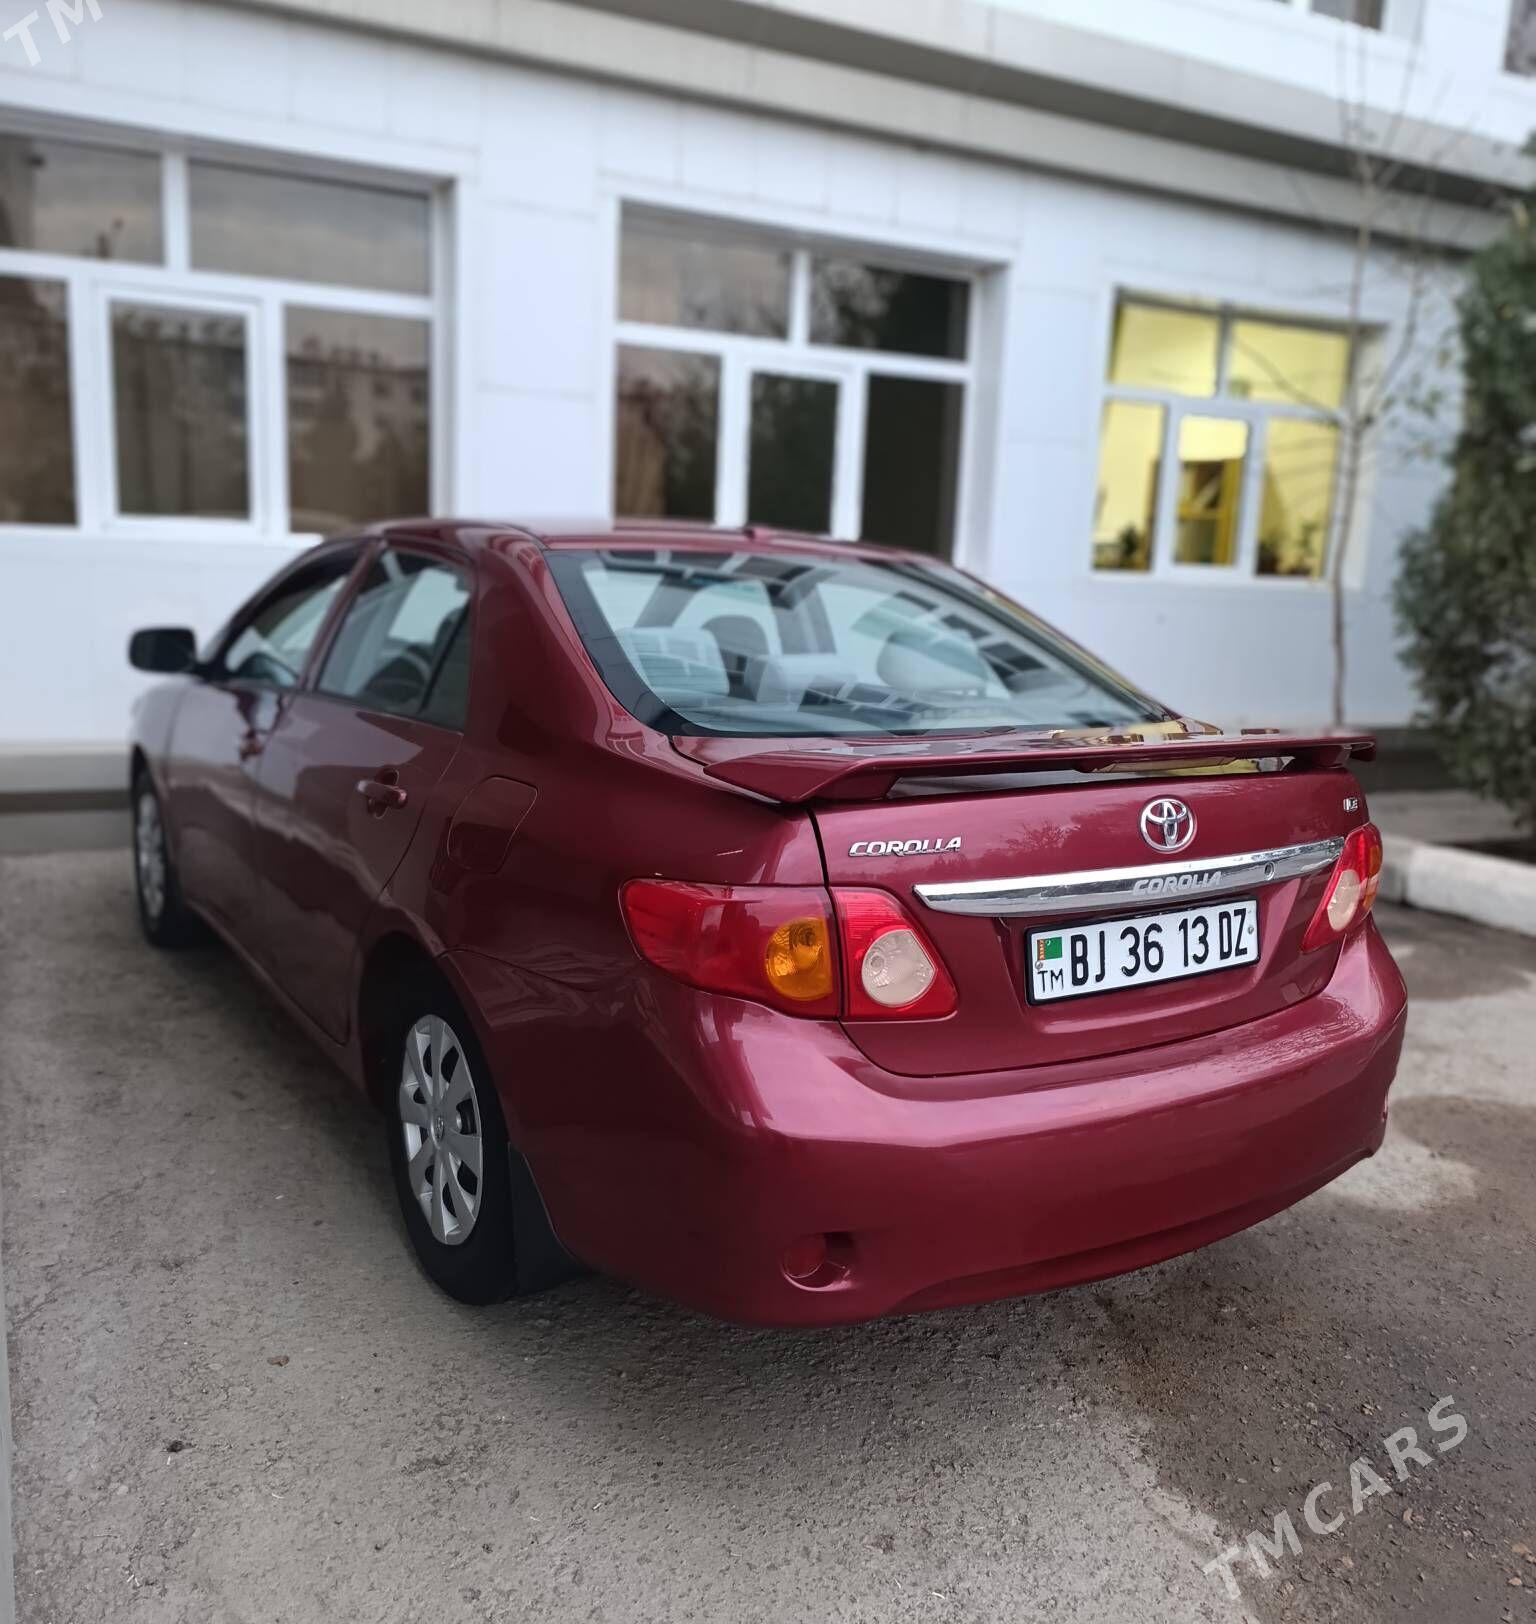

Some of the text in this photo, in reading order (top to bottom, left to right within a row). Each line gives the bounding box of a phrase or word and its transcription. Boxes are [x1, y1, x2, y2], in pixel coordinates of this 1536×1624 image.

[848, 836, 962, 857] COROLLA
[1133, 871, 1222, 896] COROLLA
[1070, 907, 1249, 987] BJ 36 13 DZ
[1037, 967, 1064, 993] TM
